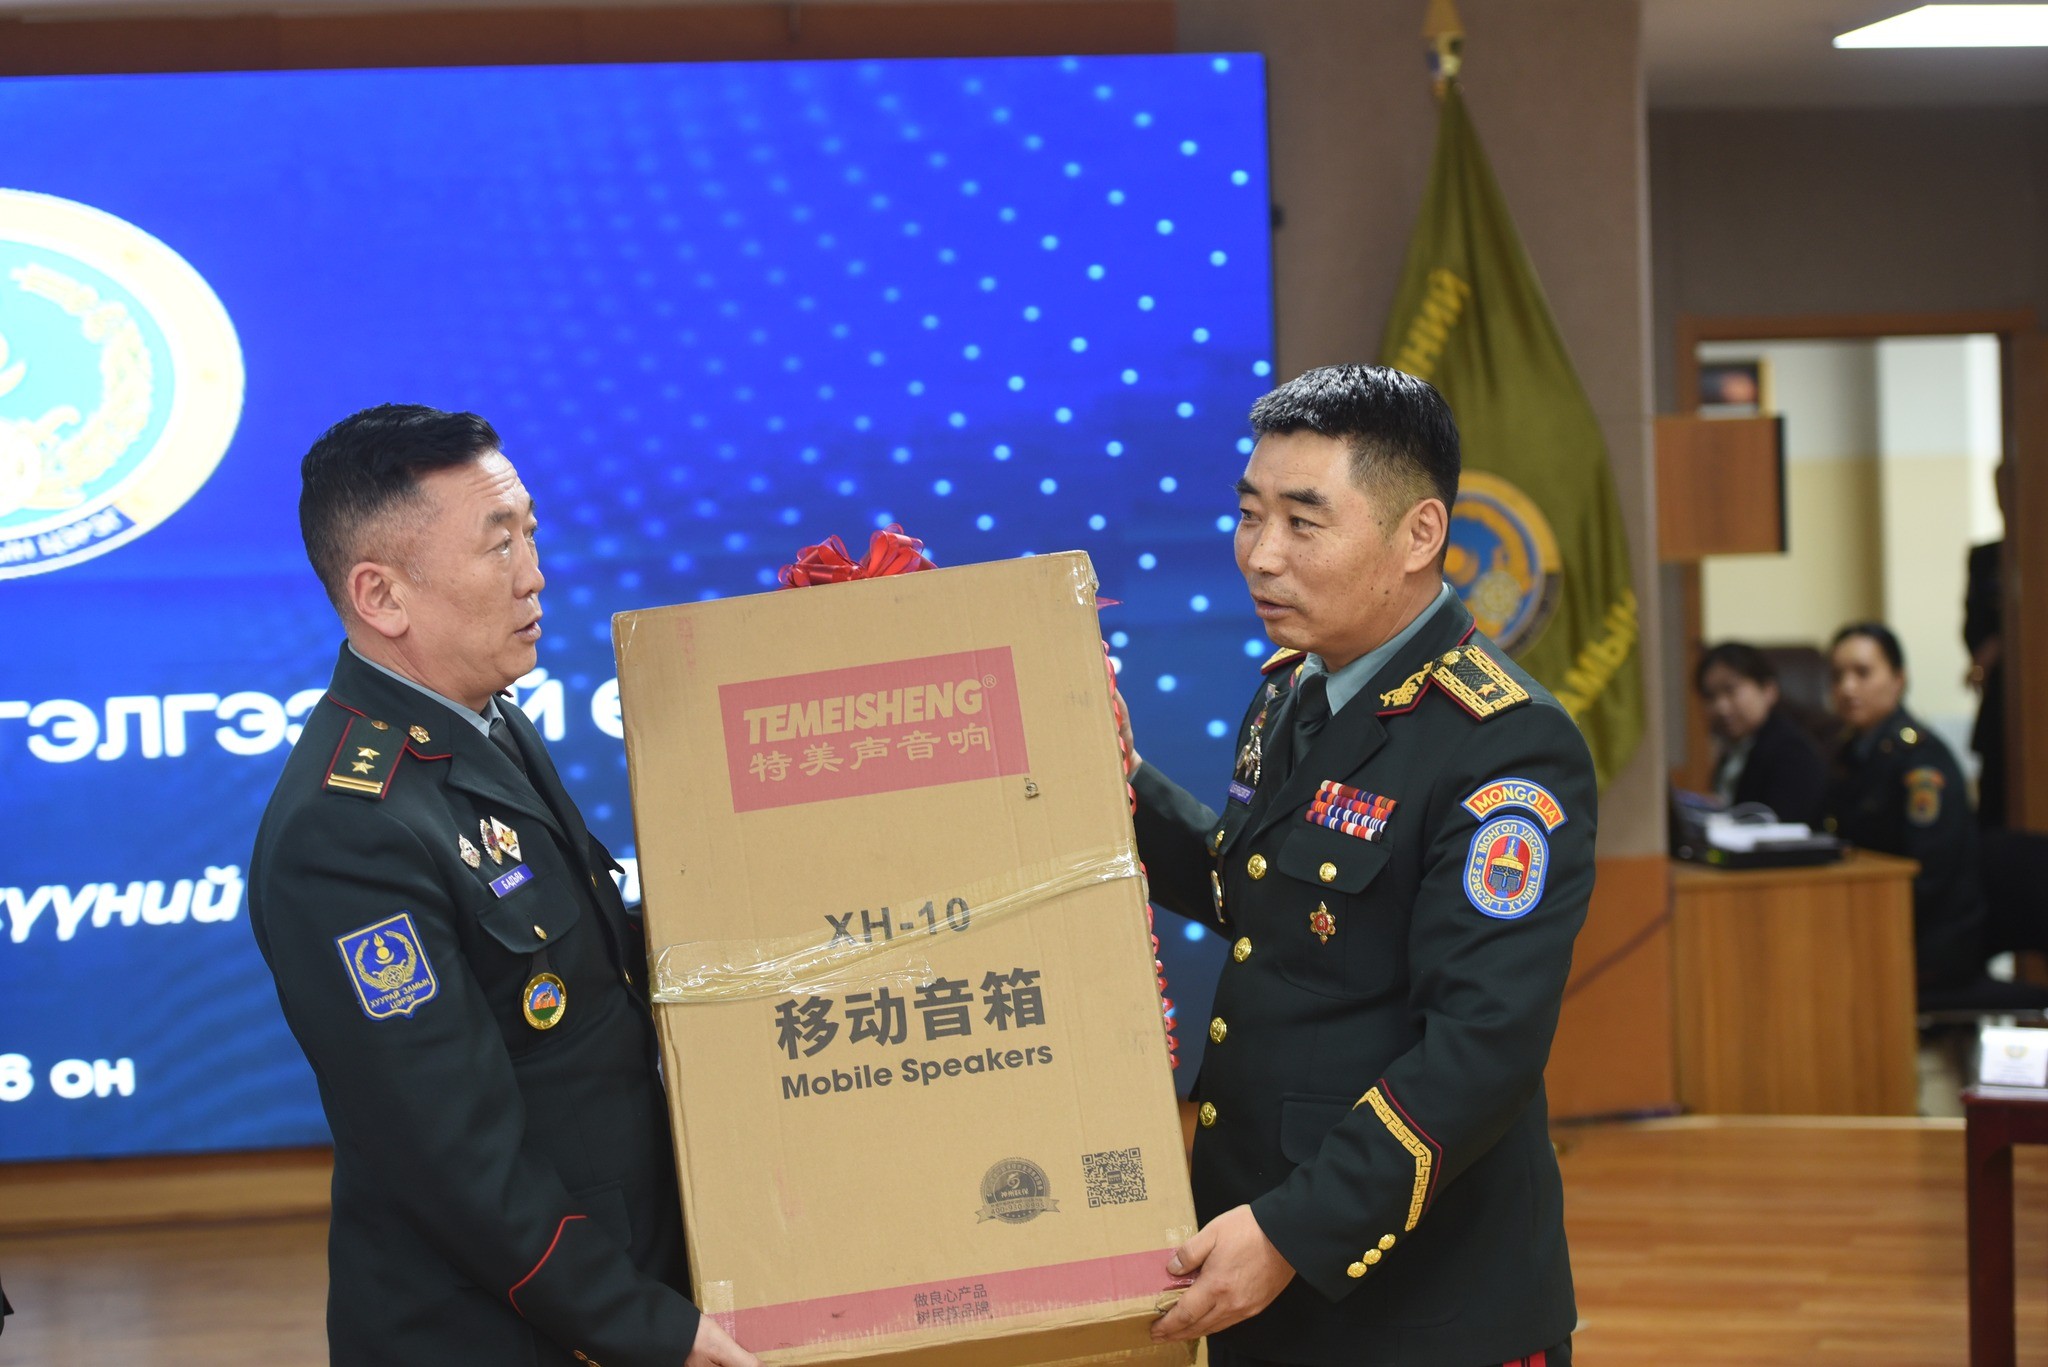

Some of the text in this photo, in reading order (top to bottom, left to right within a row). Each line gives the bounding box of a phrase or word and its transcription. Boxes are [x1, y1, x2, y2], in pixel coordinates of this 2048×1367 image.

[749, 722, 992, 783] 特美声音响
[1474, 786, 1558, 822] MONGOLIA
[1477, 824, 1540, 866] МОНГОЛ УЛСЫН
[824, 896, 972, 949] XH-10
[370, 977, 431, 1008] ХУУРАЙ ЗАМЫН
[389, 993, 415, 1009] ЦЭРЭГ
[774, 968, 1046, 1060] 移动音箱
[781, 1044, 1053, 1100] Mobile Speakers
[914, 1284, 987, 1308] 做良心产品
